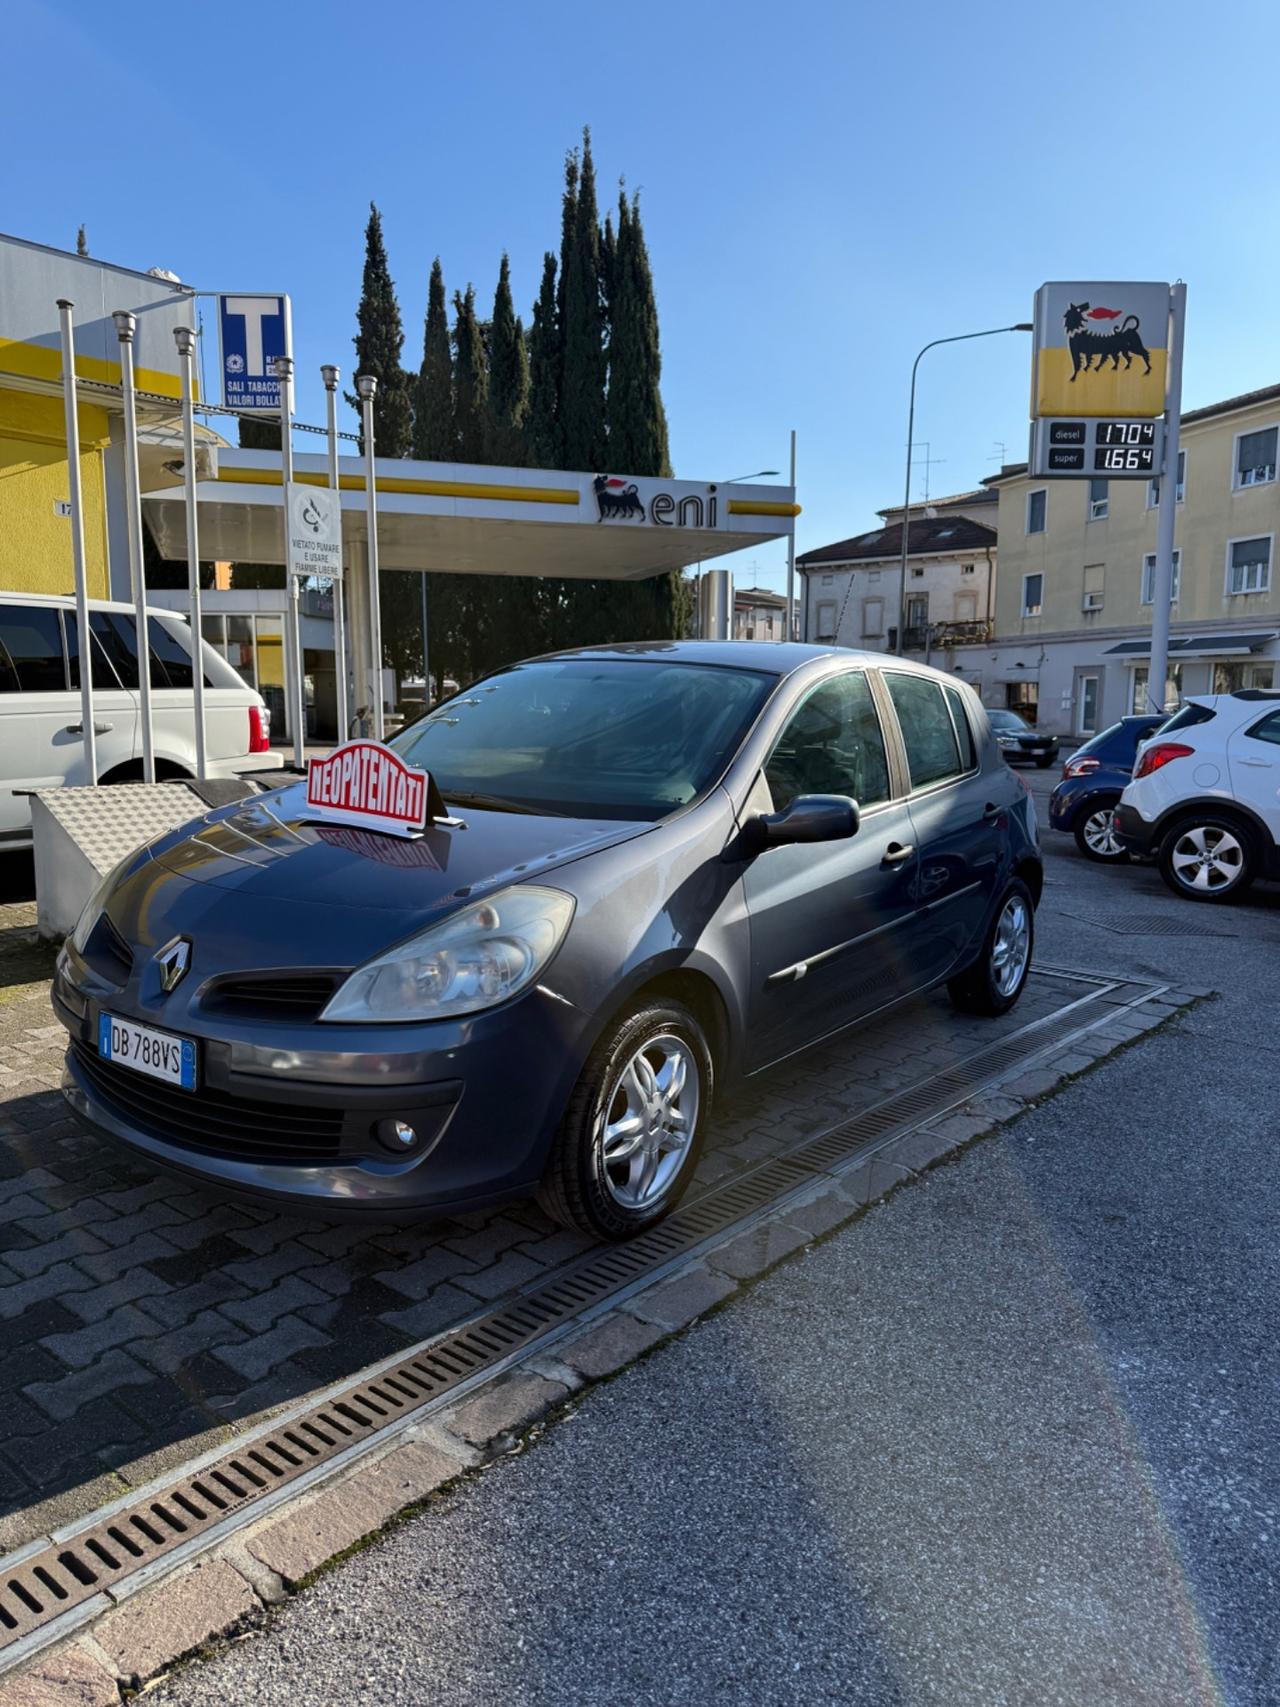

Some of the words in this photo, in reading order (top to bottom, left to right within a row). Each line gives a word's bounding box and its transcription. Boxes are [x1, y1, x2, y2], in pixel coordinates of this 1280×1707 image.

[226, 298, 280, 376] T
[227, 381, 244, 392] SALI
[248, 381, 281, 393] TABACCH
[227, 395, 254, 406] VALORI
[257, 396, 281, 407] BOLLA
[1055, 430, 1080, 439] diesel
[1054, 453, 1078, 463] super
[651, 484, 717, 528] eni
[291, 538, 316, 551] VIETATO
[316, 541, 341, 553] FUMARE
[304, 551, 309, 561] E
[309, 552, 329, 563] USARE
[295, 562, 318, 573] FIAMME
[318, 564, 338, 575] LIBERE
[311, 747, 422, 818] NEOPATENTATI
[112, 1025, 129, 1057] DB
[133, 1031, 180, 1074] 788VS
